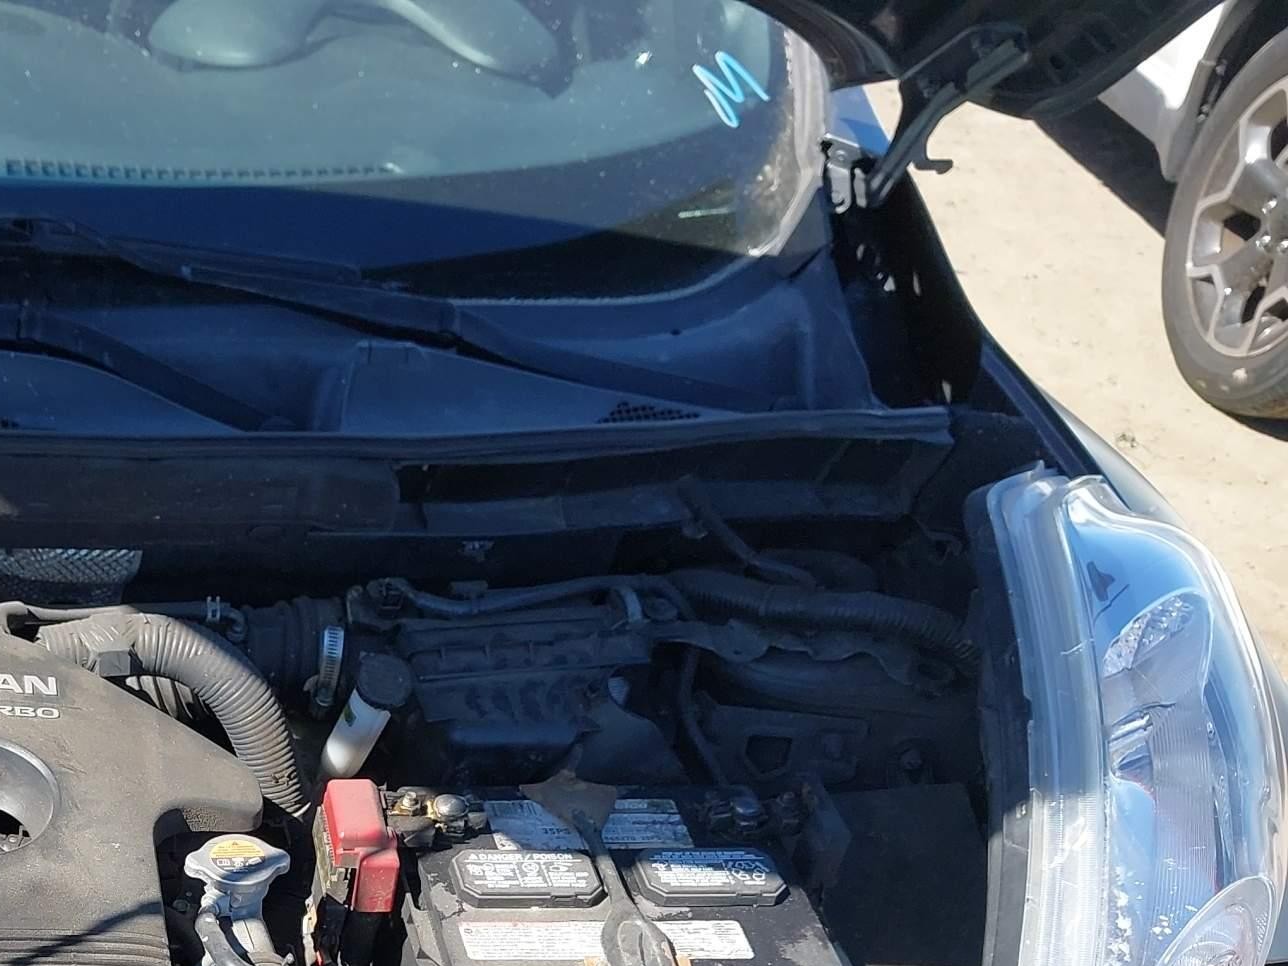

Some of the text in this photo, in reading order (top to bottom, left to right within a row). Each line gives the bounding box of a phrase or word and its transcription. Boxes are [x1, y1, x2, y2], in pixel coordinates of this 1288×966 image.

[692, 51, 770, 128] M
[478, 853, 523, 861] DANGER
[532, 853, 573, 861] POISON
